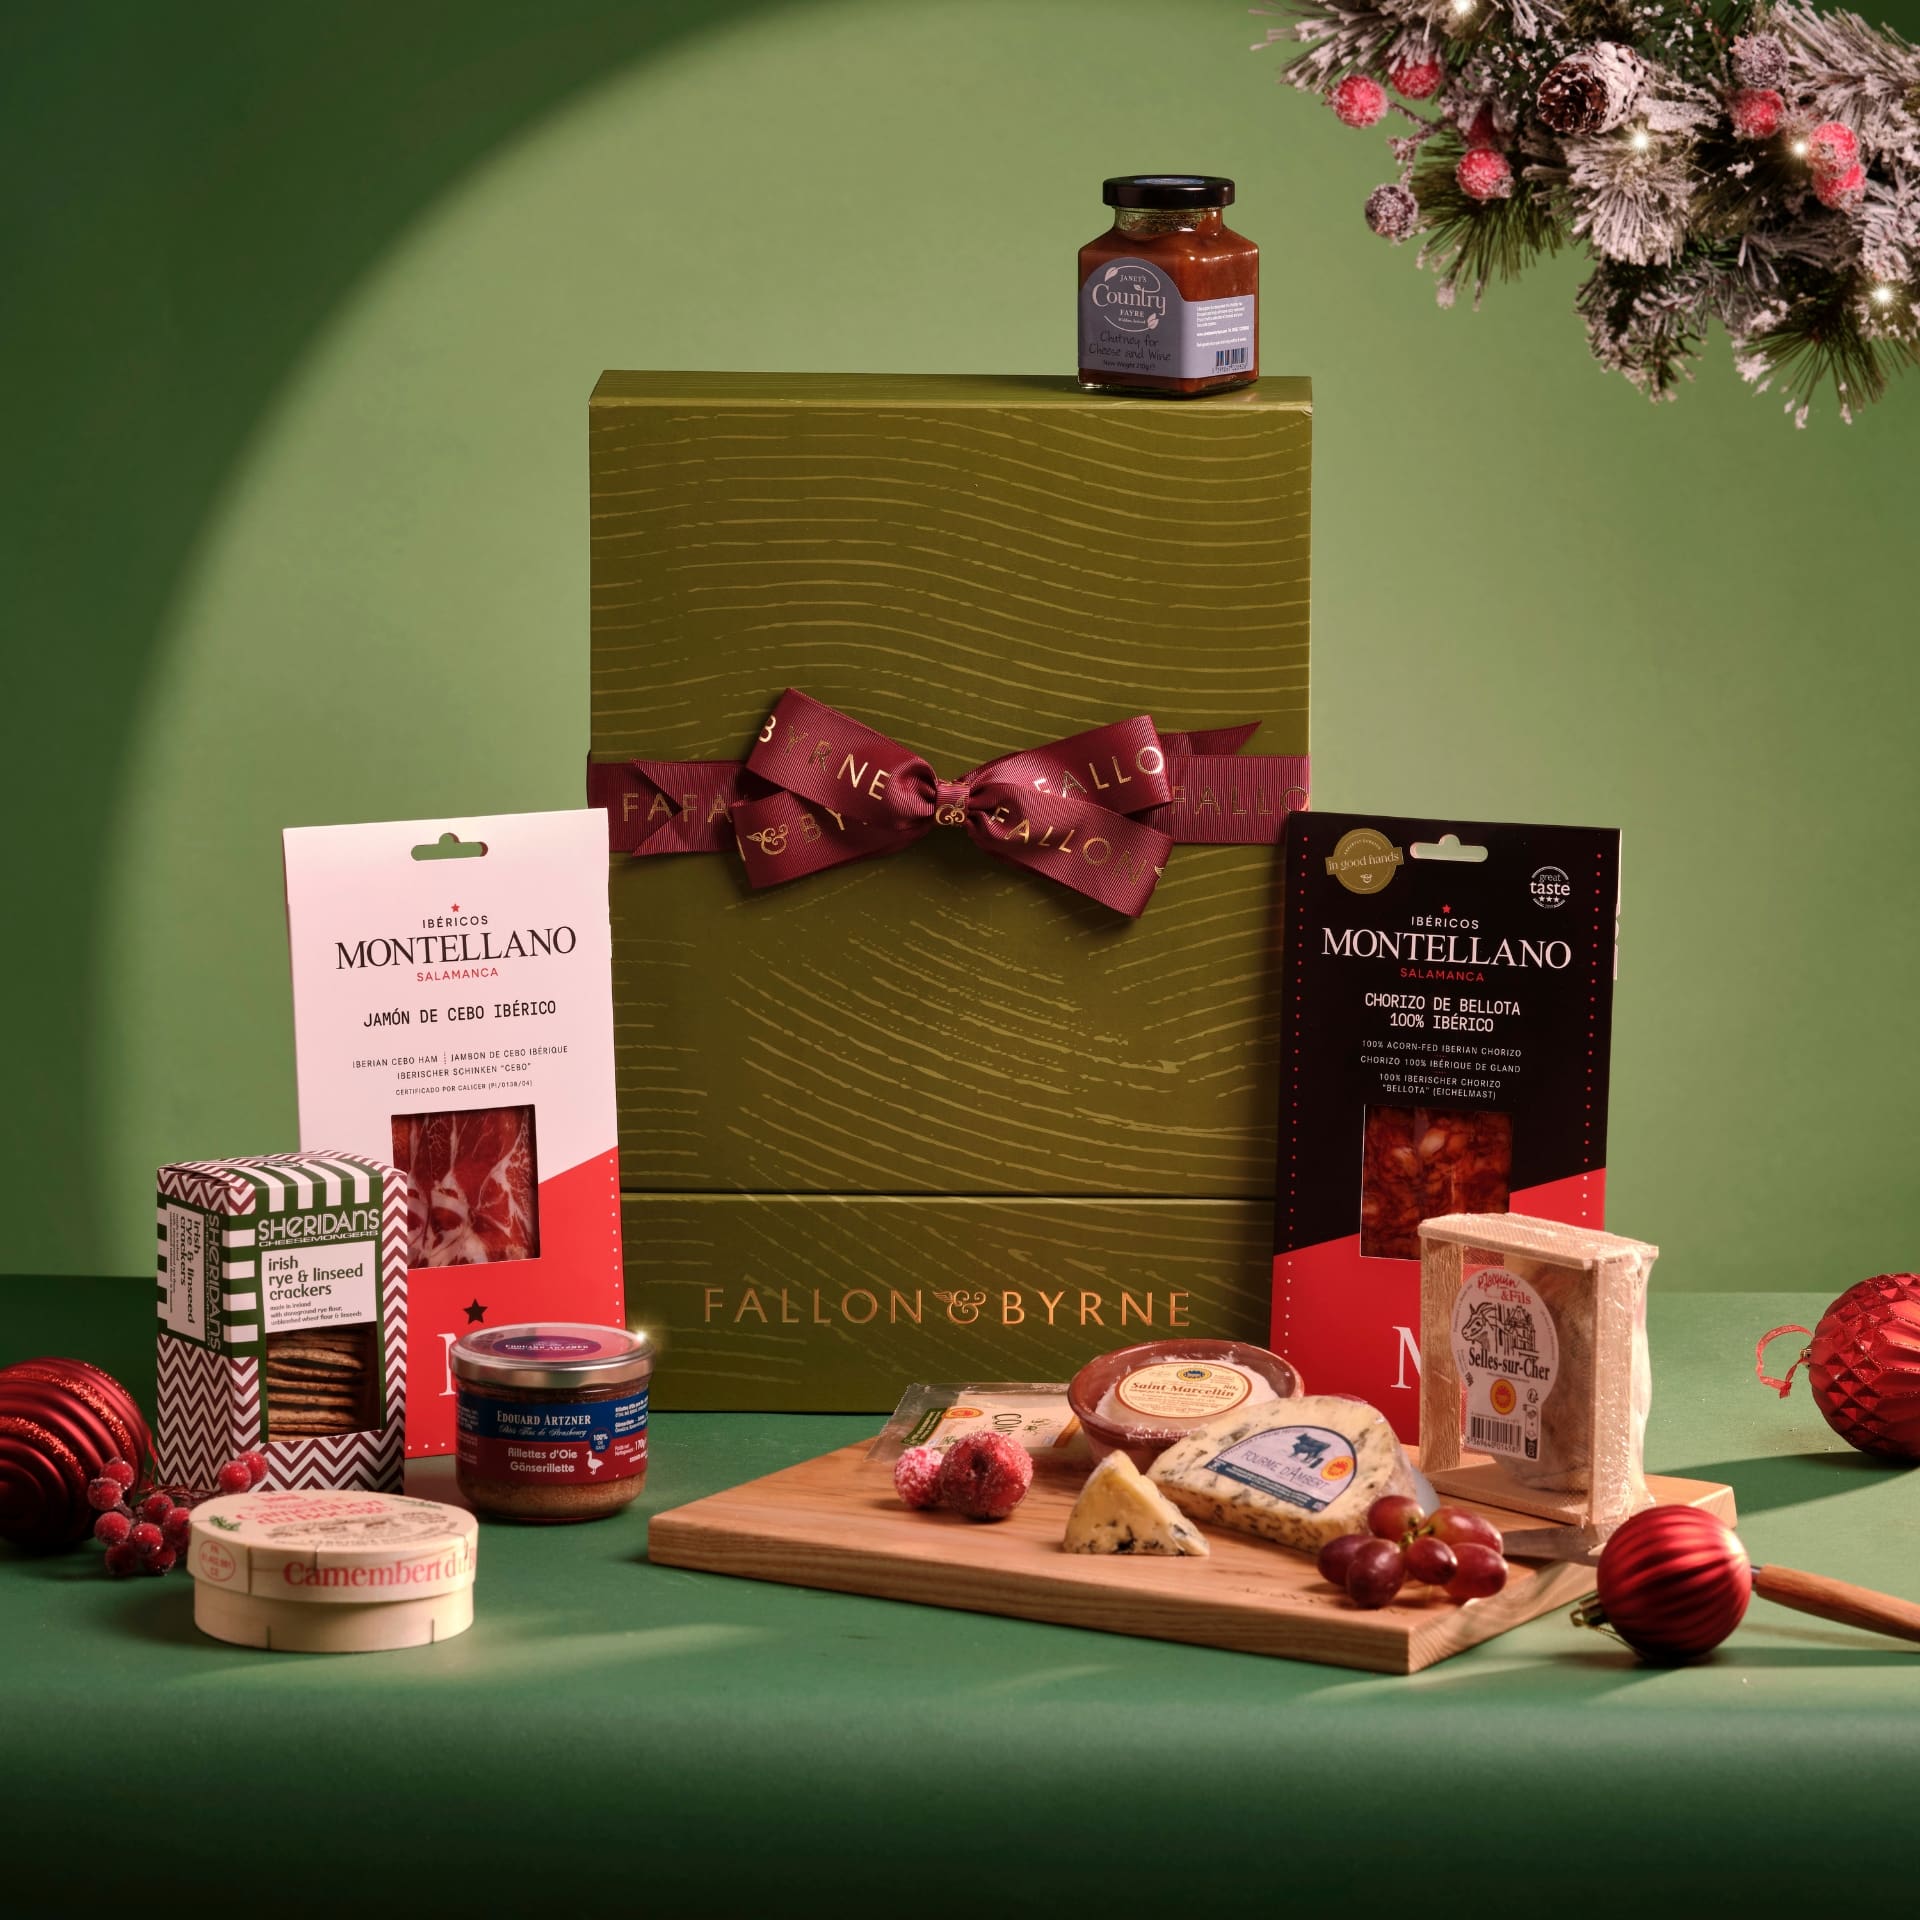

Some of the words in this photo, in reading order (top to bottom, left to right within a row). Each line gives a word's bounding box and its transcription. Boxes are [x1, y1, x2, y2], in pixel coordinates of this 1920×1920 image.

[1092, 284, 1166, 316] Country
[1120, 309, 1144, 318] FAYRE
[1100, 330, 1140, 348] Chutney
[1144, 334, 1159, 347] for
[1088, 343, 1121, 356] Cheese
[1124, 348, 1144, 359] and
[1149, 349, 1172, 361] Wine
[1328, 860, 1338, 871] in
[1340, 856, 1367, 871] good
[1368, 851, 1400, 864] hands
[1538, 874, 1562, 882] great
[1530, 881, 1570, 896] taste
[422, 914, 489, 930] IBÉRICOS
[1410, 914, 1480, 930] IBÉRICOS
[334, 925, 577, 970] MONTELLANO
[1321, 927, 1572, 970] MONTELLANO
[416, 967, 499, 982] SALAMANCA
[1400, 967, 1485, 982] SALAMANCA
[1364, 992, 1426, 1010] CHORIZO
[1433, 996, 1451, 1012] DE
[1460, 998, 1521, 1016] BELLOTA
[363, 1008, 410, 1028] JAMÓN
[420, 1009, 438, 1024] DE
[447, 1005, 485, 1022] CEBO
[494, 1000, 557, 1018] IBÉRICO
[1390, 1012, 1425, 1028] 100%
[1432, 1012, 1494, 1033] IBÉRICO
[352, 1058, 388, 1069] IBERIAN
[391, 1056, 415, 1066] CEBO
[418, 1055, 438, 1064] HAM
[451, 1052, 486, 1062] JAMBON
[488, 1050, 500, 1059] DE
[504, 1048, 526, 1058] CEBO
[529, 1045, 568, 1056] IBÉRIQUE
[1362, 1040, 1384, 1048] 100%
[1386, 1041, 1438, 1052] ACORN-FED
[1442, 1044, 1478, 1054] IBERIAN
[1481, 1048, 1522, 1058] CHORIZO
[397, 1068, 449, 1080] IBERISCHER
[453, 1065, 498, 1076] SCHINKEN
[1360, 1056, 1400, 1066] CHORIZO
[1404, 1058, 1426, 1067] 100%
[1430, 1059, 1472, 1070] IBÉRIQUE
[1475, 1063, 1487, 1071] DE
[1490, 1064, 1521, 1073] GLAND
[1380, 1073, 1400, 1082] 100%
[1404, 1074, 1457, 1086] IBERISCHER
[1460, 1078, 1501, 1088] CHORIZO
[396, 1086, 440, 1096] CERTIFICADO
[442, 1085, 456, 1093] POR
[1433, 1087, 1496, 1100] (EICHELMAST)
[194, 1220, 202, 1254] irish
[258, 1230, 379, 1248] CHEESEMONGERS
[268, 1255, 298, 1272] irish
[269, 1274, 293, 1288] rye
[298, 1270, 308, 1282] &
[313, 1263, 364, 1282] linseed
[187, 1268, 196, 1324] linseed
[270, 1284, 332, 1300] crackers
[704, 1287, 922, 1325] FALLON
[1002, 1290, 1191, 1328] BYRNE
[1468, 1346, 1551, 1382] Selles-sur-Cher
[1132, 1382, 1166, 1391] Saint
[1170, 1384, 1234, 1398] Marcellin
[544, 1414, 592, 1426] ARTZNER
[508, 1448, 547, 1460] Rillettes
[549, 1449, 578, 1459] d'Oie
[1240, 1450, 1281, 1472] FOURME
[510, 1460, 575, 1473] Gänserillette
[283, 1558, 441, 1587] Camembert
